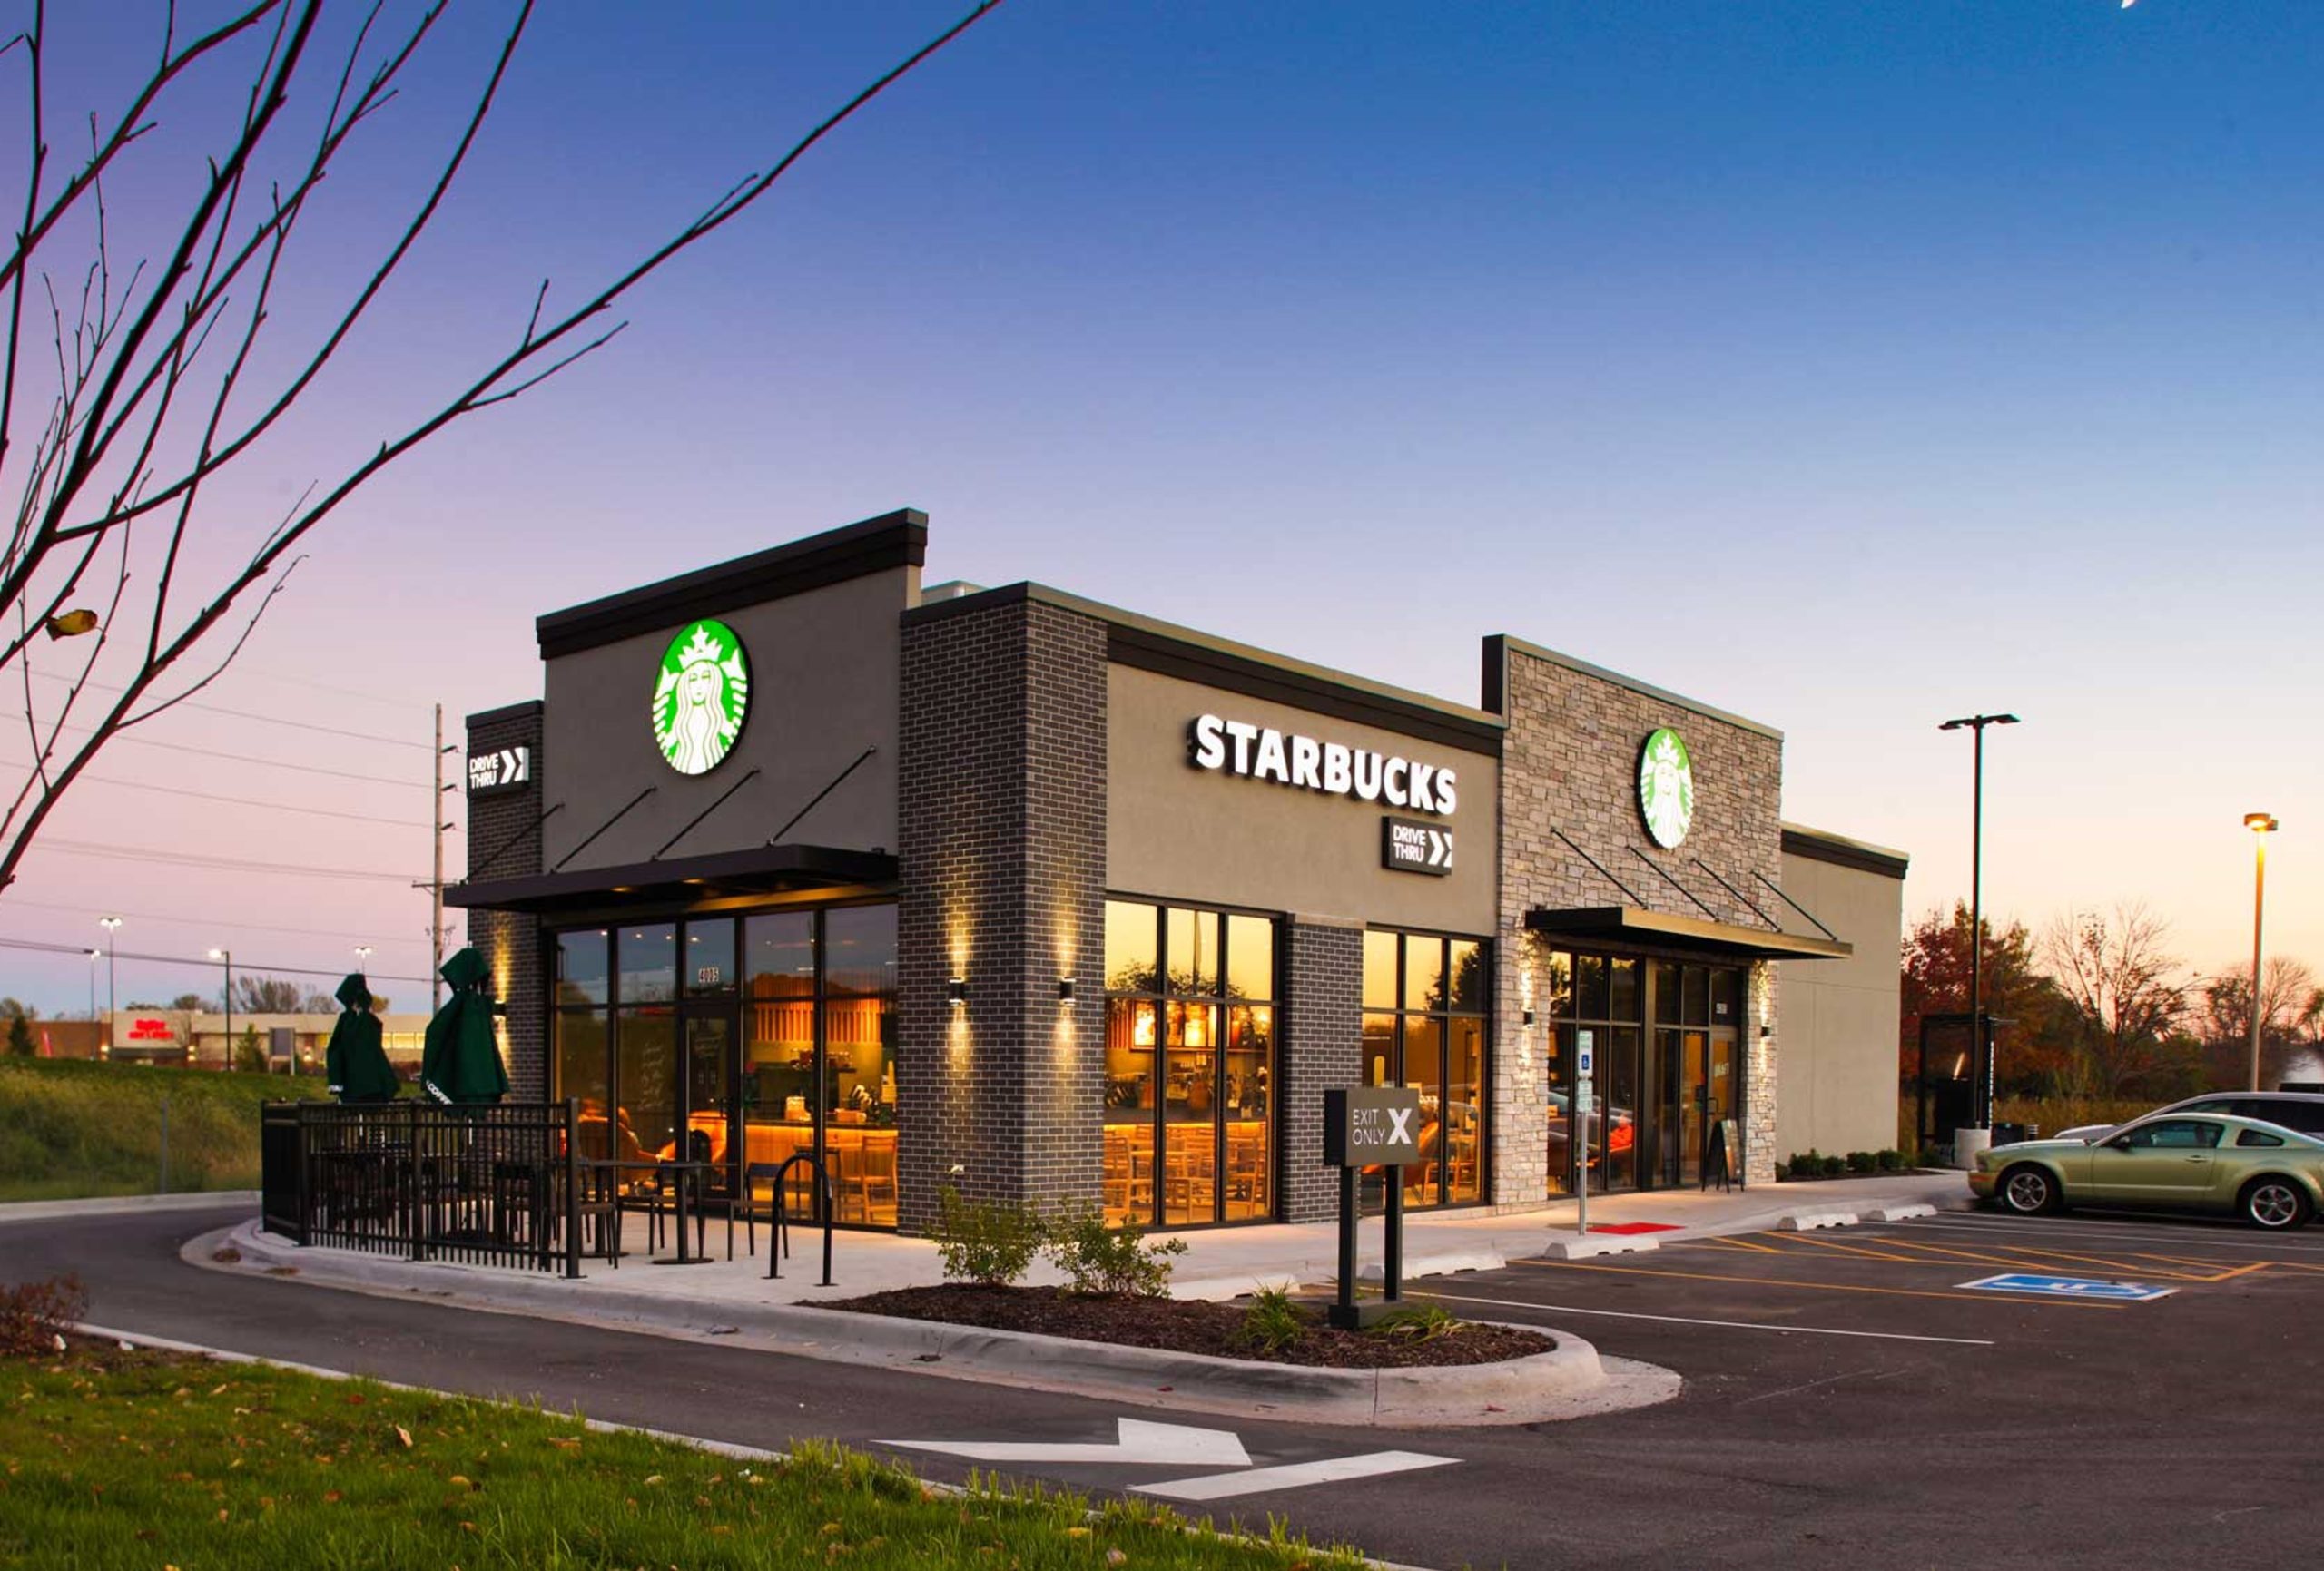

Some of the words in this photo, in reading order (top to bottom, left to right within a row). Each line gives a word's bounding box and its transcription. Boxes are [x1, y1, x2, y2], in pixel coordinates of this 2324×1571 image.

[469, 752, 499, 773] DRIVE
[1196, 713, 1457, 815] STARBUCKS
[469, 770, 497, 790] THRU
[1393, 824, 1427, 847] DRIVE
[1393, 841, 1424, 863] THRU
[1353, 1108, 1380, 1126] EXIT
[1352, 1127, 1386, 1146] ONLY
